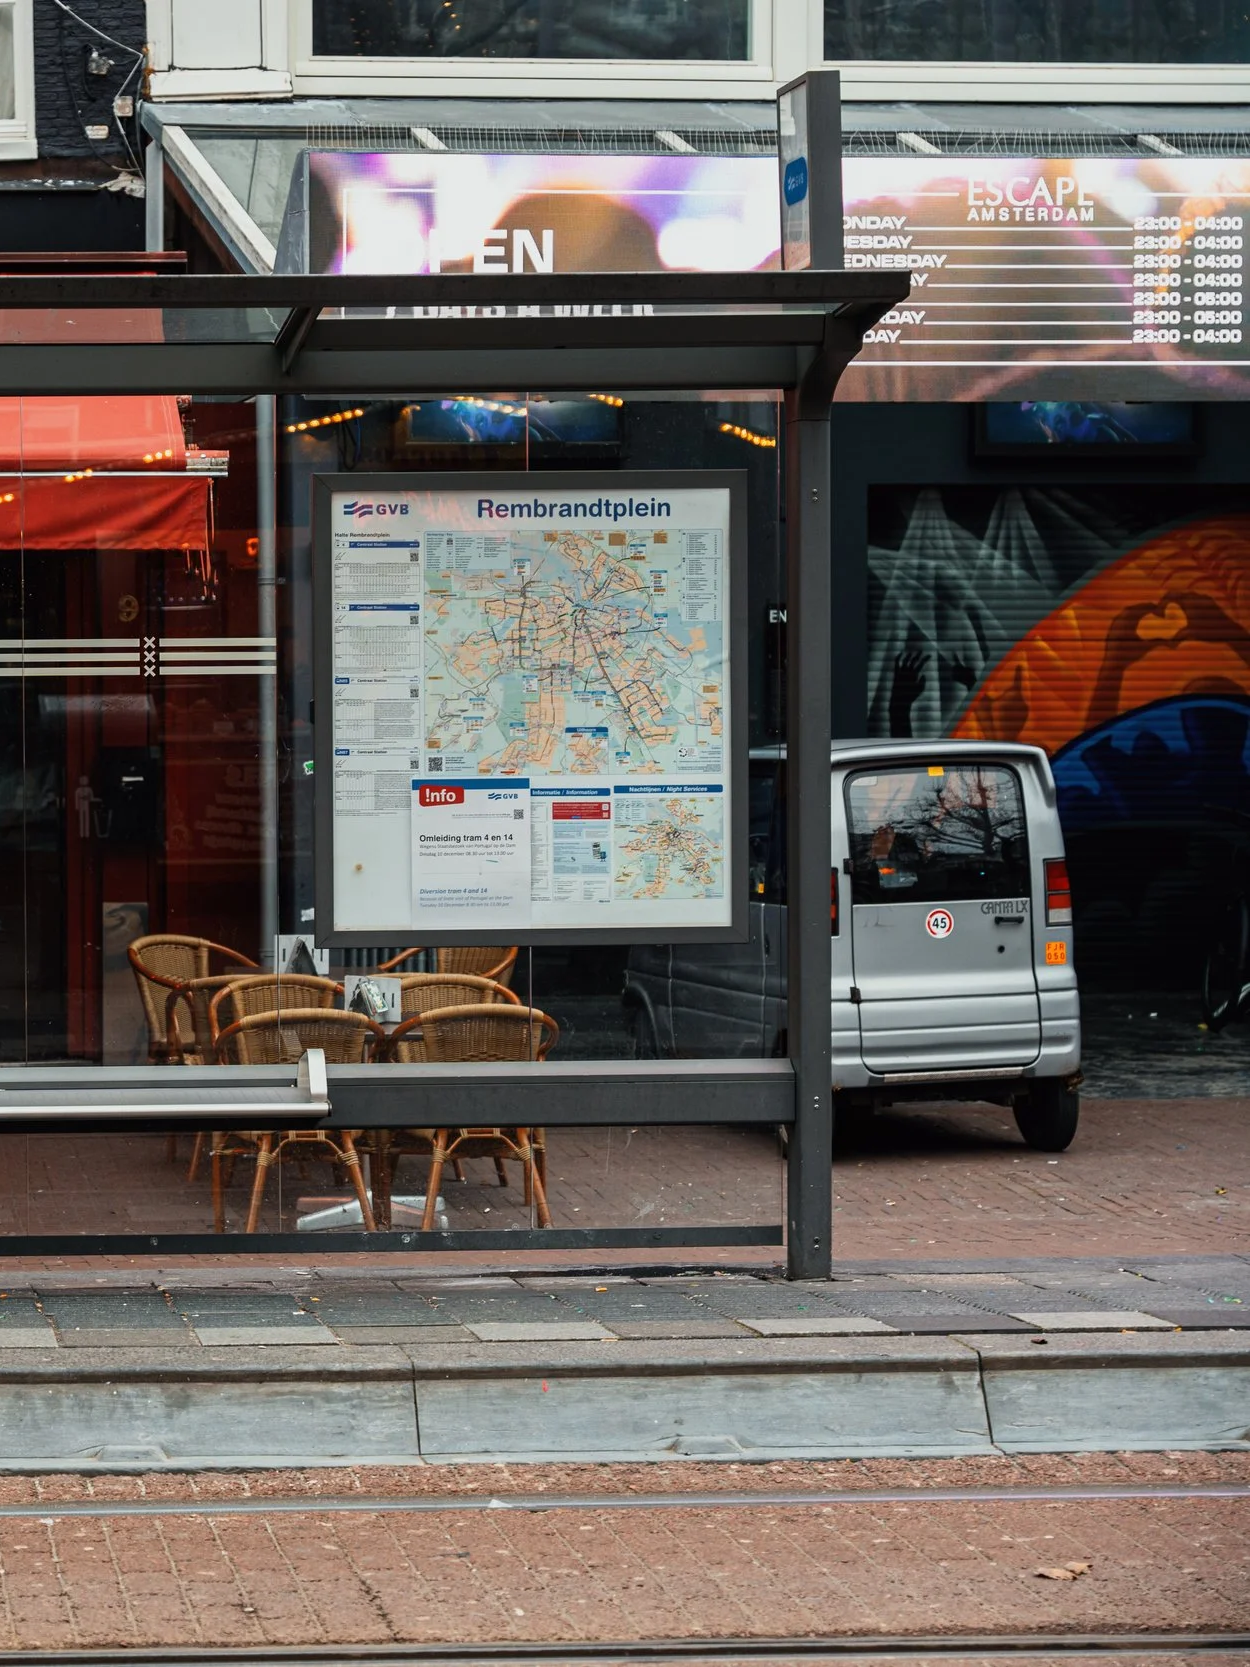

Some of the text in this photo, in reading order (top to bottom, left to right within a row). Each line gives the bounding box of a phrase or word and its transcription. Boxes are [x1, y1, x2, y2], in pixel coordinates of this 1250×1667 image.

[968, 176, 1094, 206] ESCAPE
[967, 208, 1094, 222] AMSTERDAM
[1133, 217, 1181, 230] 23:00
[1194, 217, 1243, 230] 04:00
[1133, 236, 1181, 249] 23:00
[1193, 236, 1242, 249] 04:00
[1133, 255, 1181, 268] 23:00
[1193, 255, 1242, 268] 04:00
[1133, 273, 1181, 287] 23:00
[1193, 273, 1242, 287] 04:00
[1133, 292, 1181, 305] 23:00
[1193, 292, 1242, 305] 05:00
[1133, 311, 1181, 324] 23:00
[1193, 311, 1241, 324] 05:00
[1132, 330, 1180, 343] 23:00
[1193, 330, 1241, 343] 04:00
[376, 504, 409, 515] GVB
[477, 498, 671, 522] Rembrandtplein
[770, 610, 787, 623] EN
[426, 788, 456, 802] !nfo
[419, 835, 461, 843] Omleiding
[981, 901, 1028, 914] CANTA LX
[932, 918, 947, 929] 45
